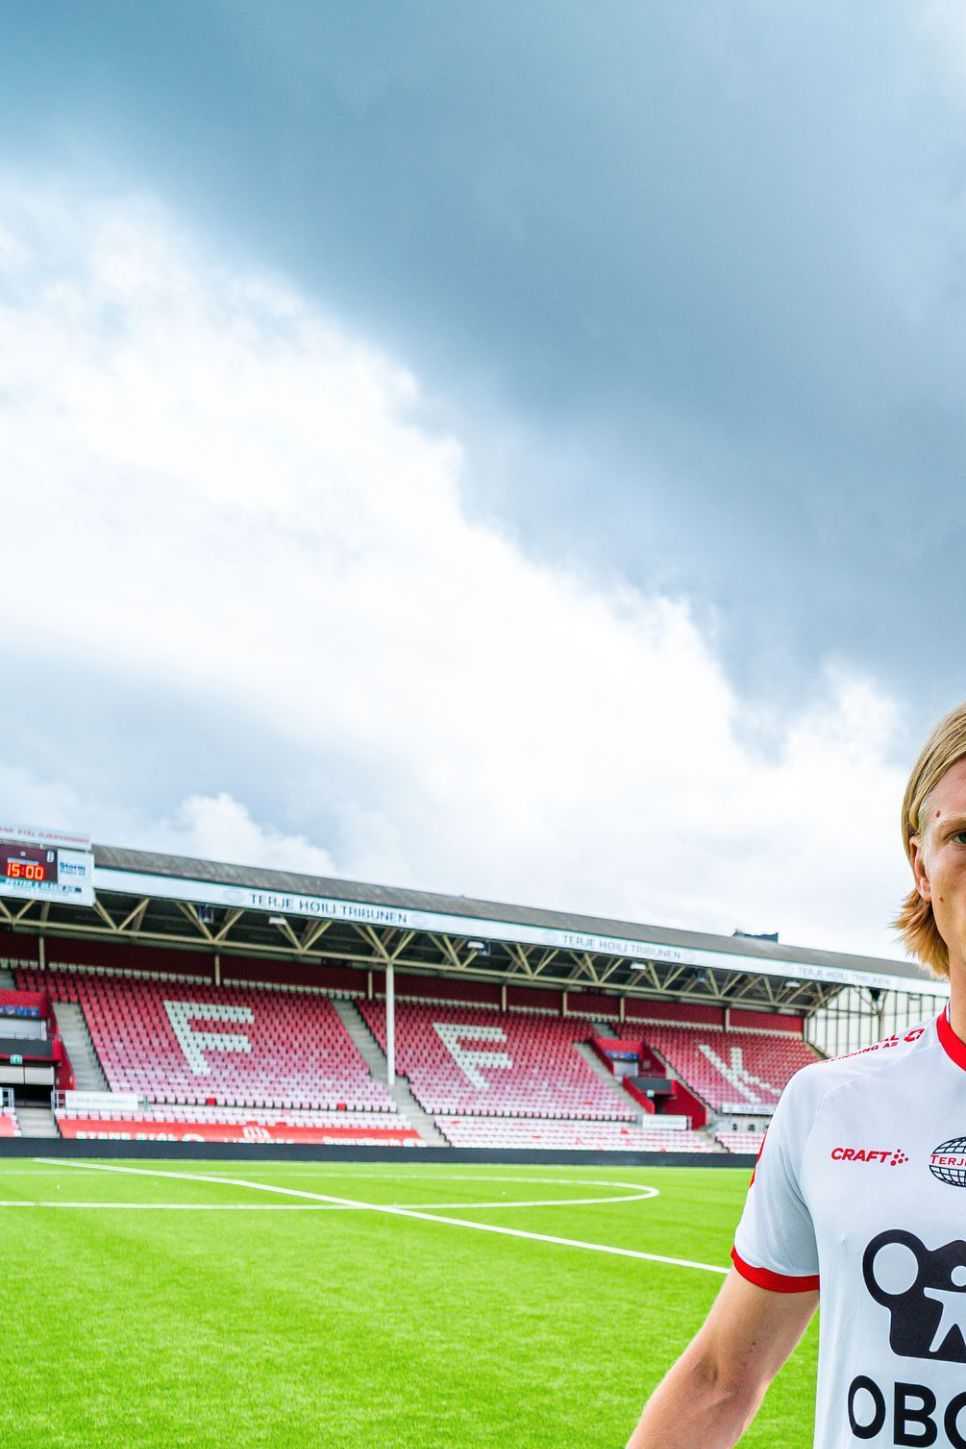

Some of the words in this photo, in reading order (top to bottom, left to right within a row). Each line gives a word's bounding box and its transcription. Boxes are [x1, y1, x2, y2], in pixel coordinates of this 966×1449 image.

[7, 863, 45, 880] 15:00
[249, 894, 295, 908] TERJE
[342, 905, 408, 924] TRIBUNEN
[831, 1146, 892, 1165] CRAFT
